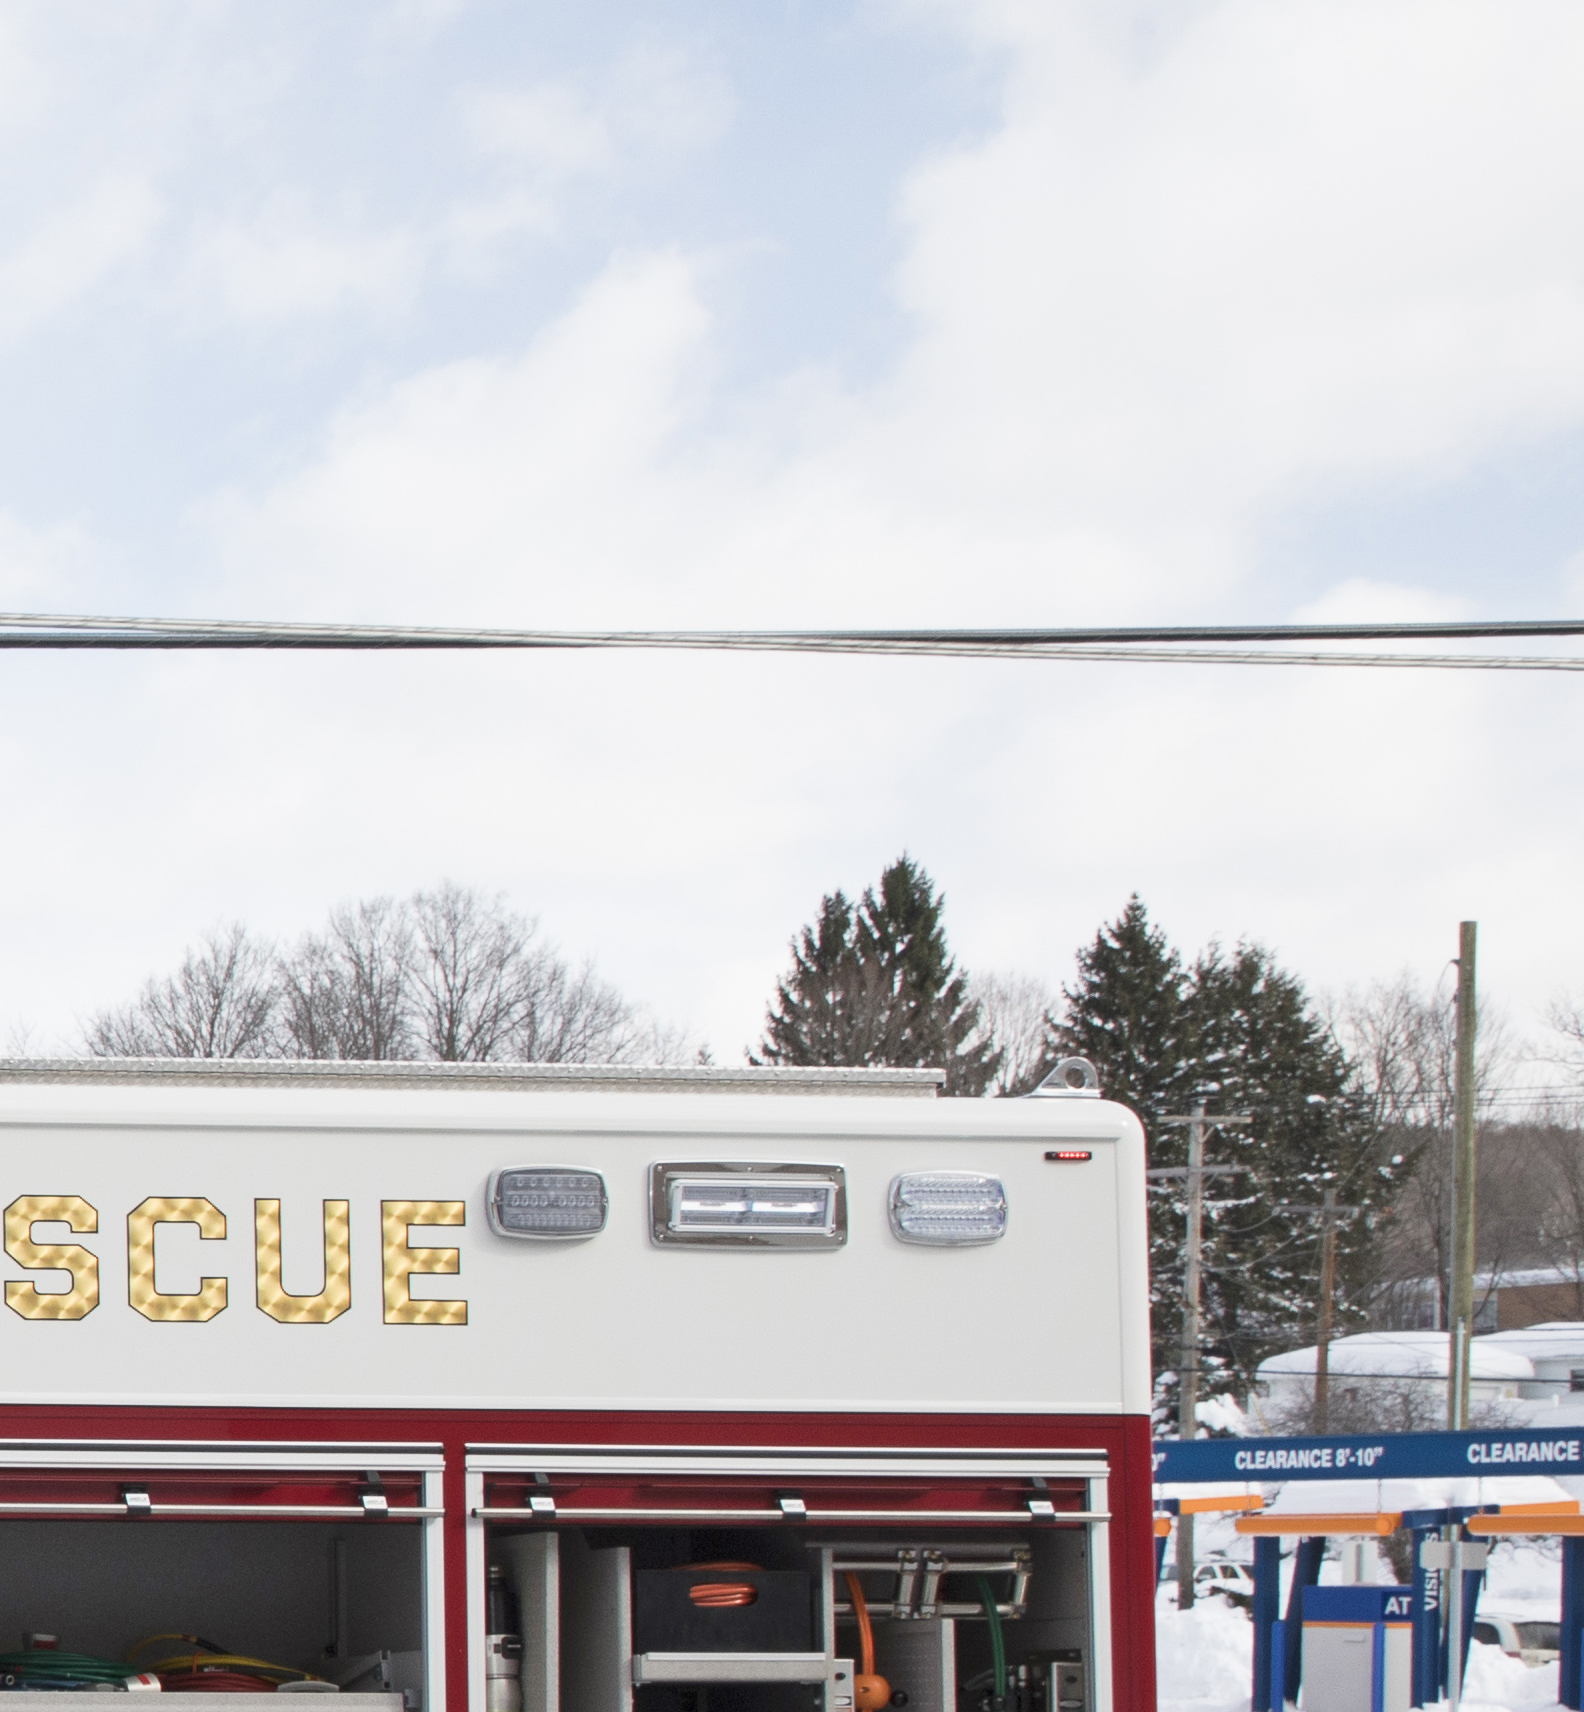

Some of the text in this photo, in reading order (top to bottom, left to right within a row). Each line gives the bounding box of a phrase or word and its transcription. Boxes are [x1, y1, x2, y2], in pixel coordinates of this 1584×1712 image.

[1234, 1448, 1333, 1470] CLEARANCE
[1466, 1440, 1581, 1464] CLEARANCE
[1423, 1532, 1439, 1612] VISIS
